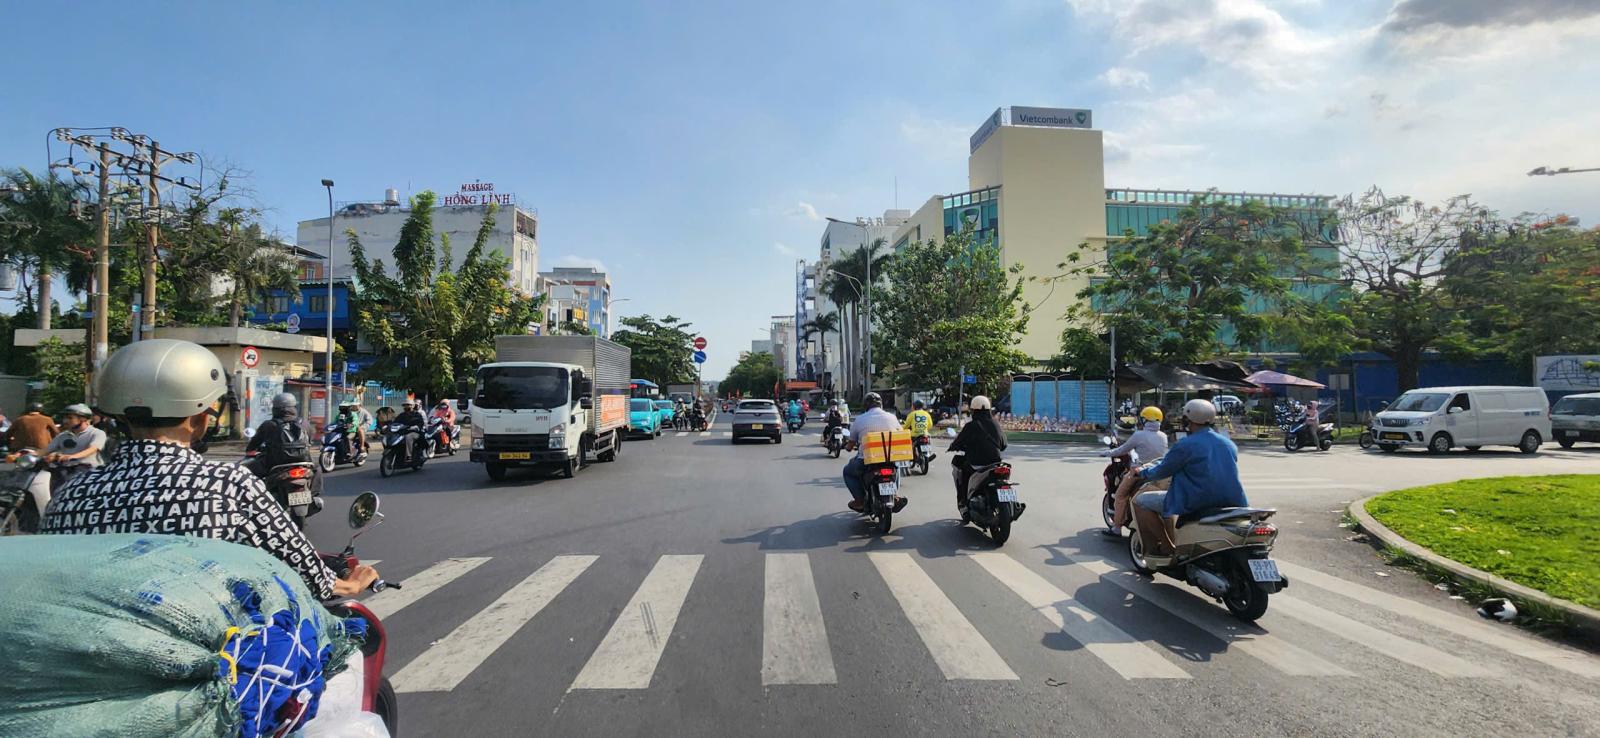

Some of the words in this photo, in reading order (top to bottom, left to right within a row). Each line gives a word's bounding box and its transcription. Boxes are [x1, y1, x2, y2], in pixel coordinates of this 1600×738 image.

[1020, 114, 1073, 125] Vietcombank
[461, 183, 494, 192] MASSAGE
[914, 411, 927, 423] be
